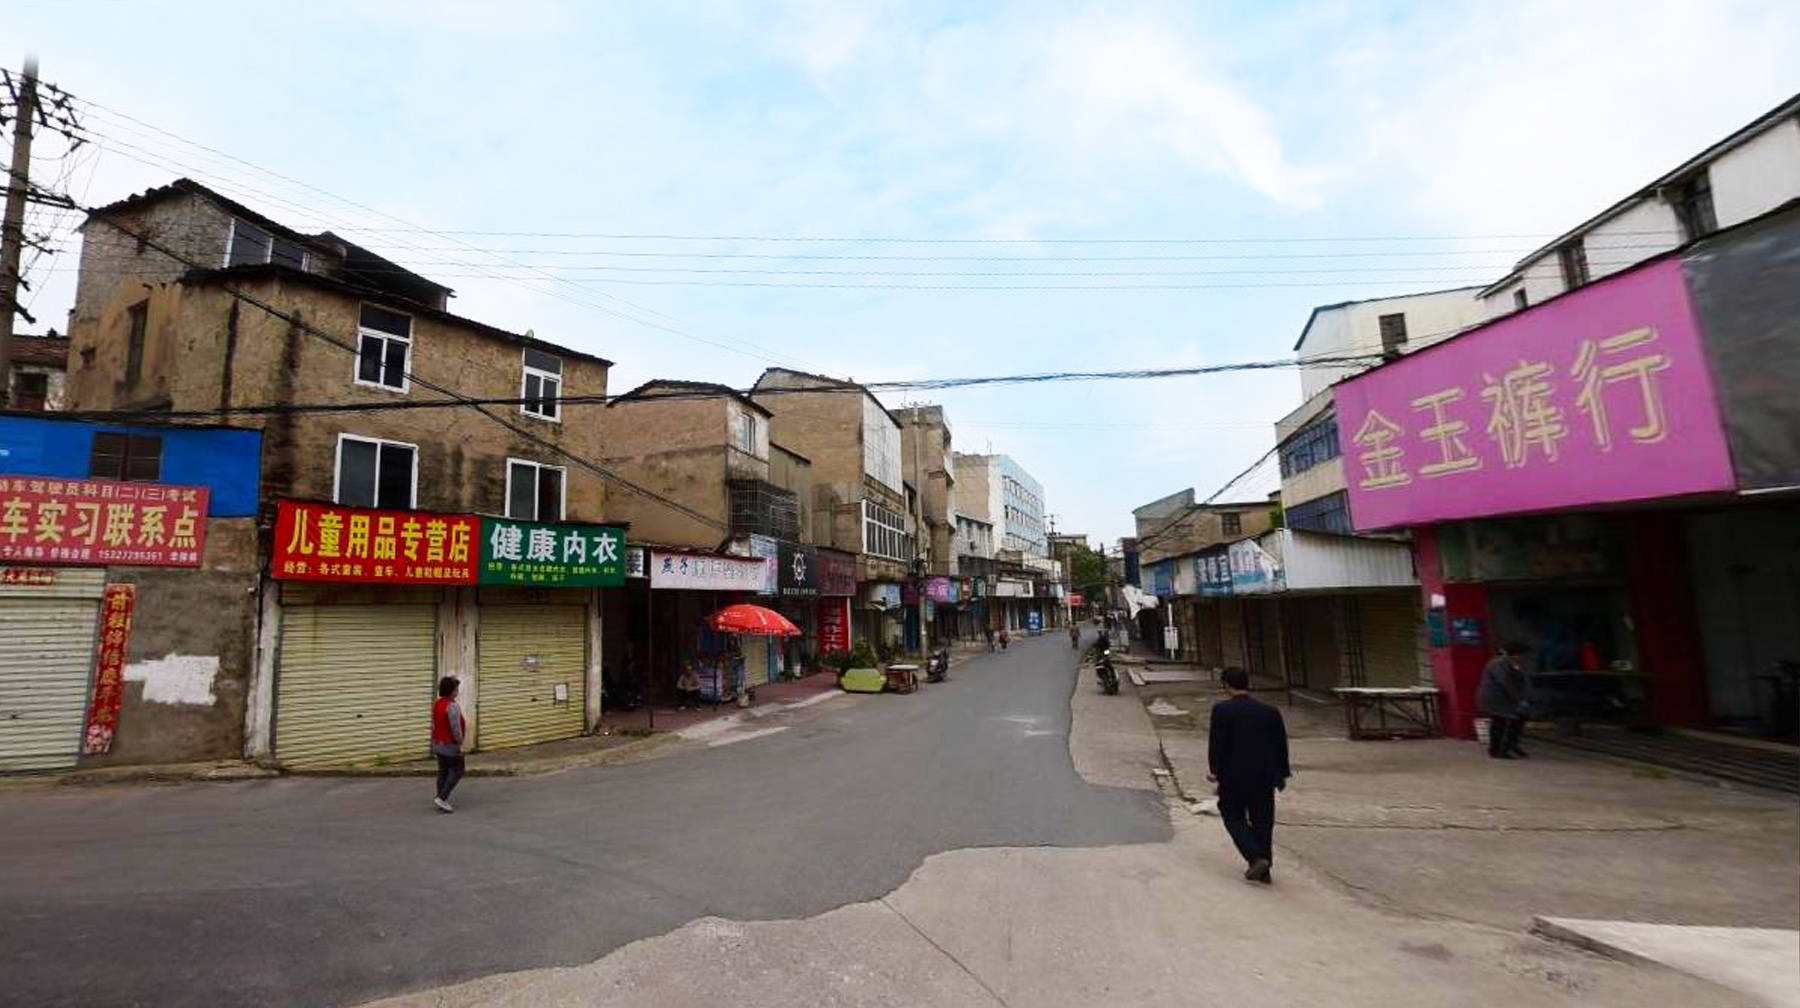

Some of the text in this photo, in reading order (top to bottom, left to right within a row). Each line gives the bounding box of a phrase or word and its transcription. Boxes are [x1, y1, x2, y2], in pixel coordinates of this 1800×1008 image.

[0, 497, 199, 548] 车实习联系点
[287, 508, 471, 563] 儿童用品专营店
[490, 523, 618, 564] 健康内衣
